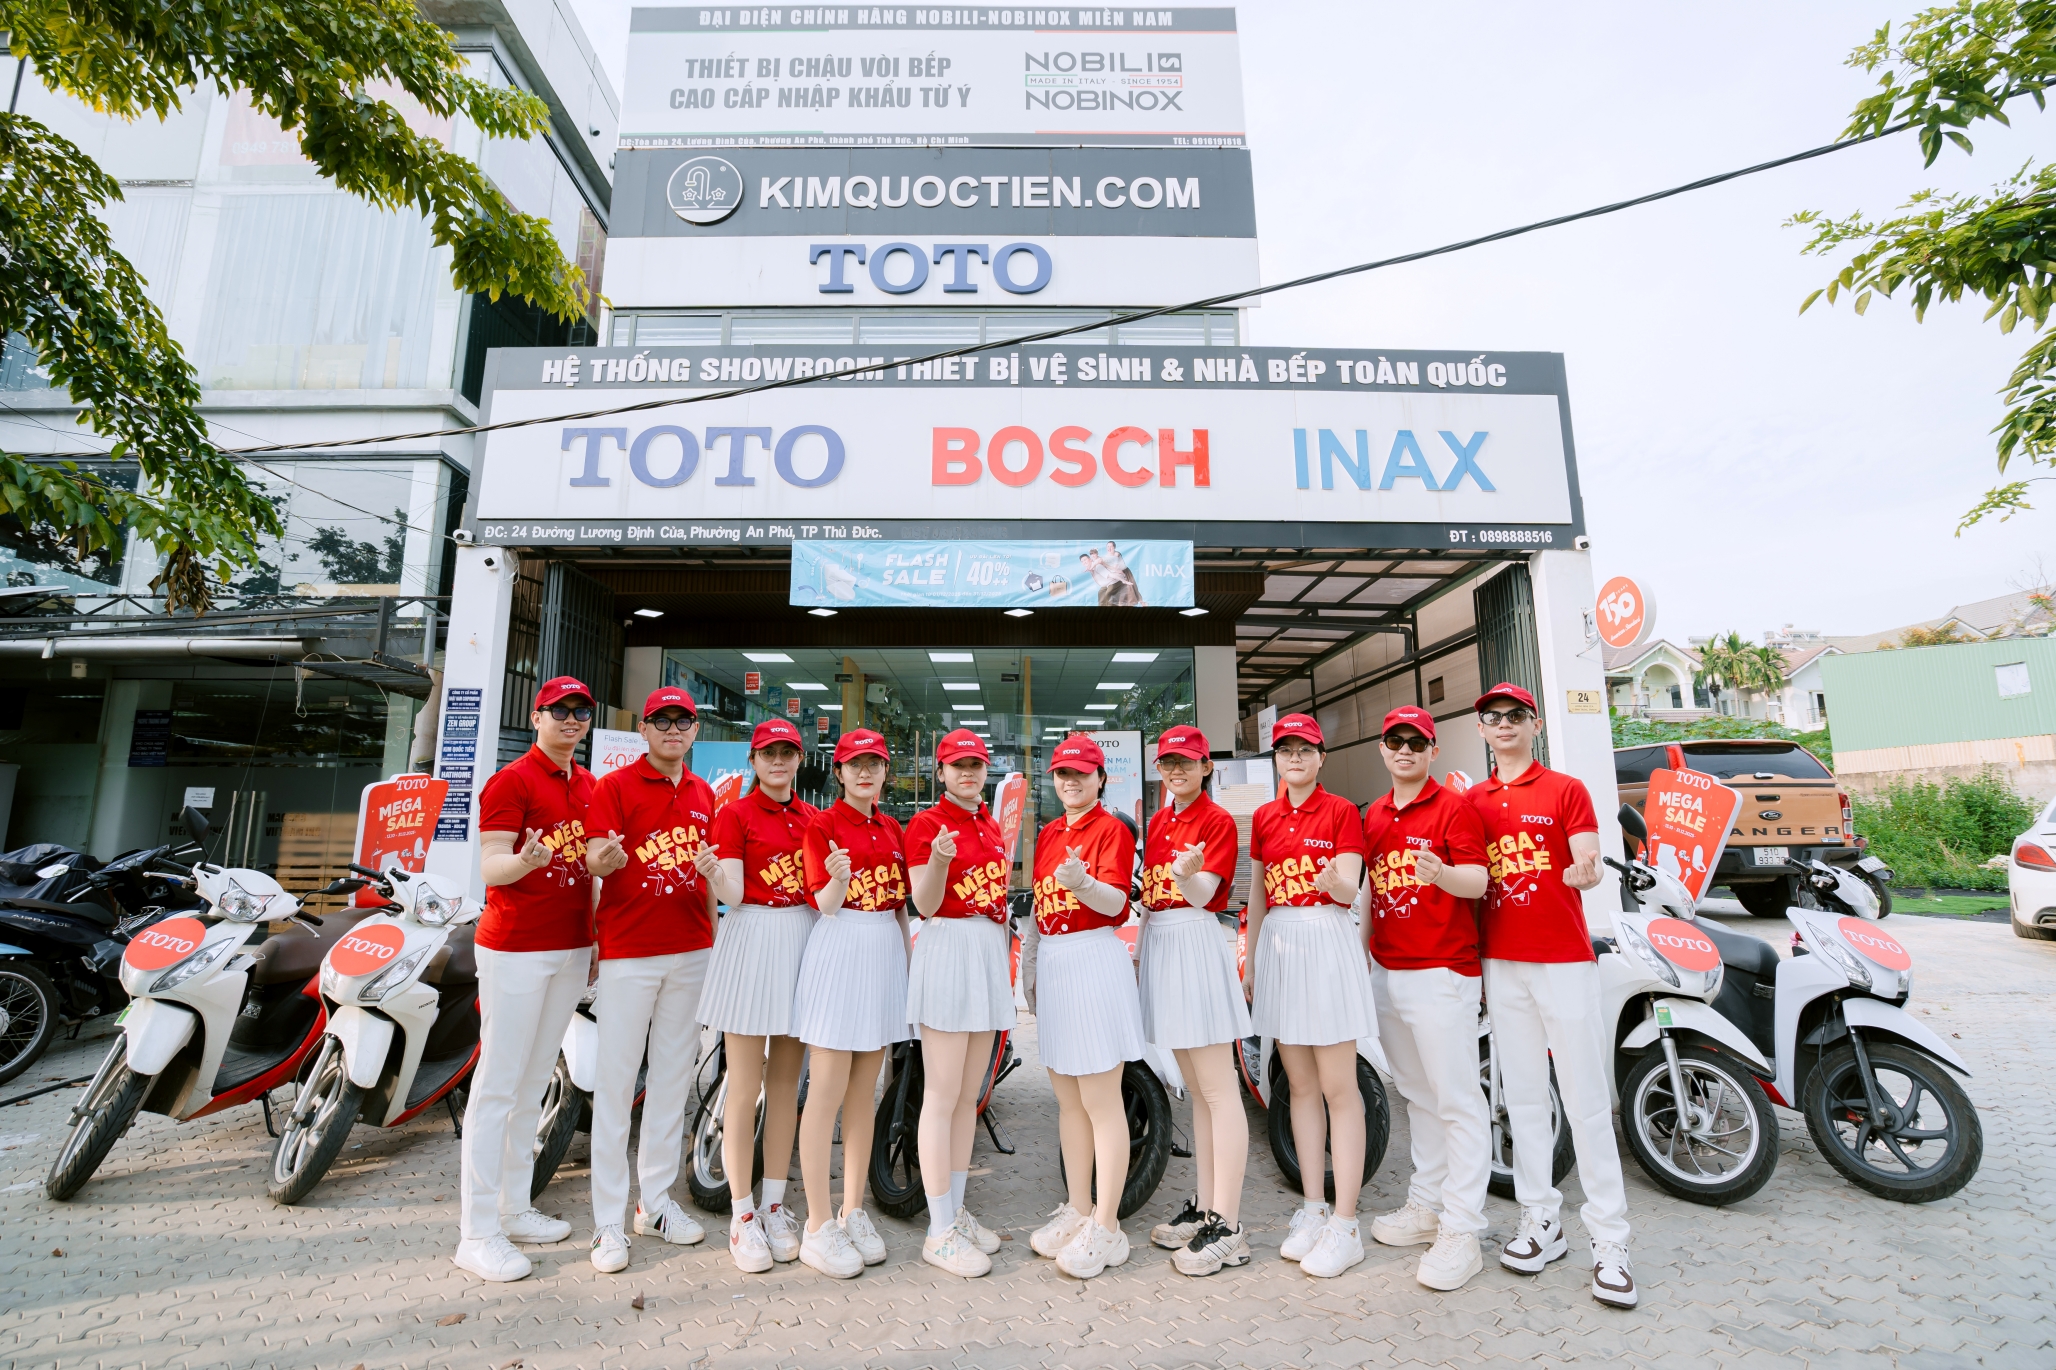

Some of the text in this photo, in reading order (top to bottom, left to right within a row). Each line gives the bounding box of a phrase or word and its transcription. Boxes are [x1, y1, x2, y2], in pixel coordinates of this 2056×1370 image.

[699, 7, 1173, 28] ĐẠI DIỆN CHÍNH HÃNG NOBILI-NOBINOX MIỀN NAM
[685, 50, 952, 82] THIẾT BỊ CHẬU VÒI BẾP
[1025, 51, 1153, 73] NOBILI
[669, 79, 972, 112] CAO CẤP NHẬP KHẨU TỪ Ý
[1025, 90, 1184, 111] NOBINOX
[1173, 137, 1190, 145] TEL:
[759, 175, 1201, 210] KIMQUOCTIEN.COM
[808, 242, 1053, 295] TOTO
[541, 357, 579, 387] HỆ
[590, 353, 691, 383] THỐNG
[700, 357, 884, 382] SHOWROOM
[1030, 356, 1068, 385] VỆ
[1160, 357, 1185, 382] &
[1194, 354, 1259, 383] NHÀ
[1268, 352, 1327, 384] BẾP
[1336, 356, 1420, 386] TOÀN
[1427, 354, 1508, 389] QUỐC
[560, 424, 846, 489] TOTO
[931, 425, 1211, 488] BOSCH
[1292, 427, 1497, 492] INAX
[484, 525, 508, 538] ĐC:
[512, 525, 527, 538] 24
[580, 526, 622, 541] Lương
[627, 526, 654, 541] Định
[660, 525, 687, 540] Của,
[746, 525, 764, 538] An
[769, 525, 795, 540] Phú,
[801, 526, 818, 538] TP
[823, 525, 846, 538] Thủ
[852, 525, 882, 538] Đức.
[1449, 530, 1468, 542] ĐT
[1480, 530, 1552, 543] 0898888516
[885, 553, 949, 567] FLASH
[1145, 564, 1186, 578] INAX
[882, 569, 947, 586] SALE
[1599, 591, 1636, 626] 150
[1578, 692, 1589, 703] 24
[459, 720, 476, 728] GROUP
[604, 735, 623, 743] Flash
[1115, 757, 1131, 766] MẠI
[396, 778, 429, 791] TOTO
[1676, 771, 1711, 790] TOTO
[379, 797, 422, 821] MEGA
[1003, 797, 1018, 821] MEGA
[1658, 791, 1703, 814] MEGA
[386, 813, 425, 832] SALE
[1004, 814, 1018, 833] SALE
[1520, 815, 1554, 826] TOTO
[1665, 807, 1707, 833] SALE
[1729, 826, 1840, 836] ANGER
[542, 820, 585, 851] MEG
[635, 825, 700, 864] MEGA
[1304, 838, 1333, 849] TOTO
[657, 844, 701, 871] SAL
[1486, 831, 1536, 866] EGA
[1264, 855, 1316, 895] MEGA
[1489, 850, 1552, 884] SALE
[846, 862, 902, 902] MEGA
[861, 882, 906, 911] SALE
[1037, 891, 1080, 922] SALE
[139, 930, 195, 954] TOTO
[342, 936, 395, 959] TOTO
[1651, 932, 1712, 953] TOTO
[1843, 929, 1903, 955] TOTO
